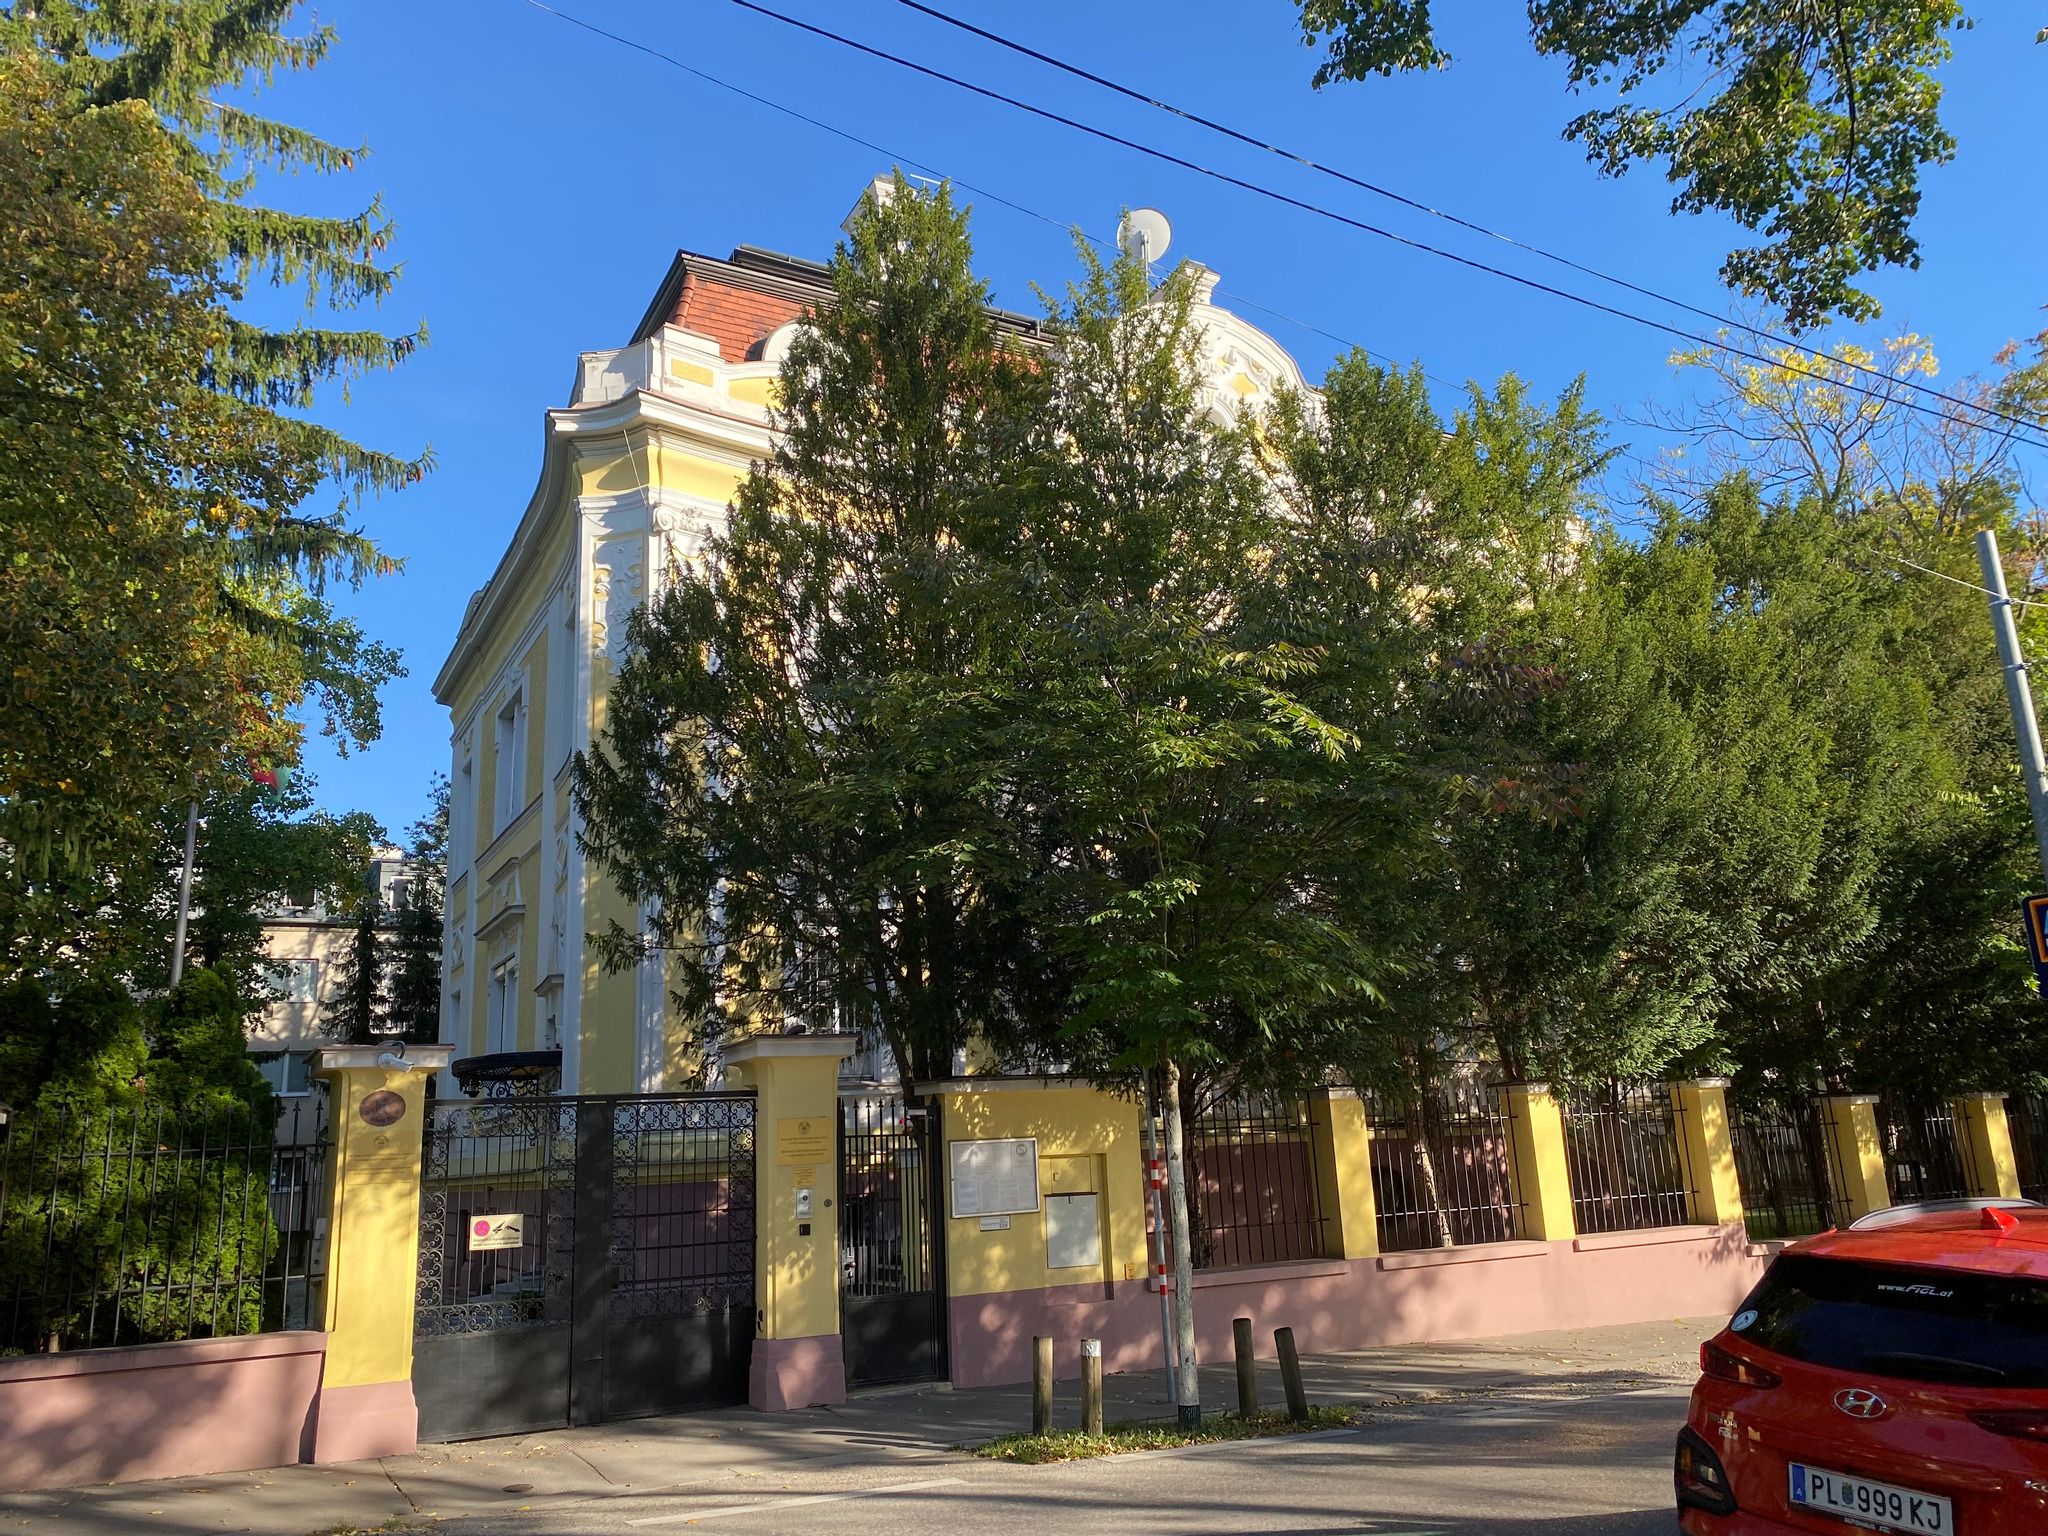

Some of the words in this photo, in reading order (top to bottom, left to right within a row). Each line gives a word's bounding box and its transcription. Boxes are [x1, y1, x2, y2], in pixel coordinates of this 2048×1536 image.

[1811, 1473, 1838, 1505] PL
[1857, 1485, 1902, 1521] 999
[1909, 1496, 1941, 1531] KJ
